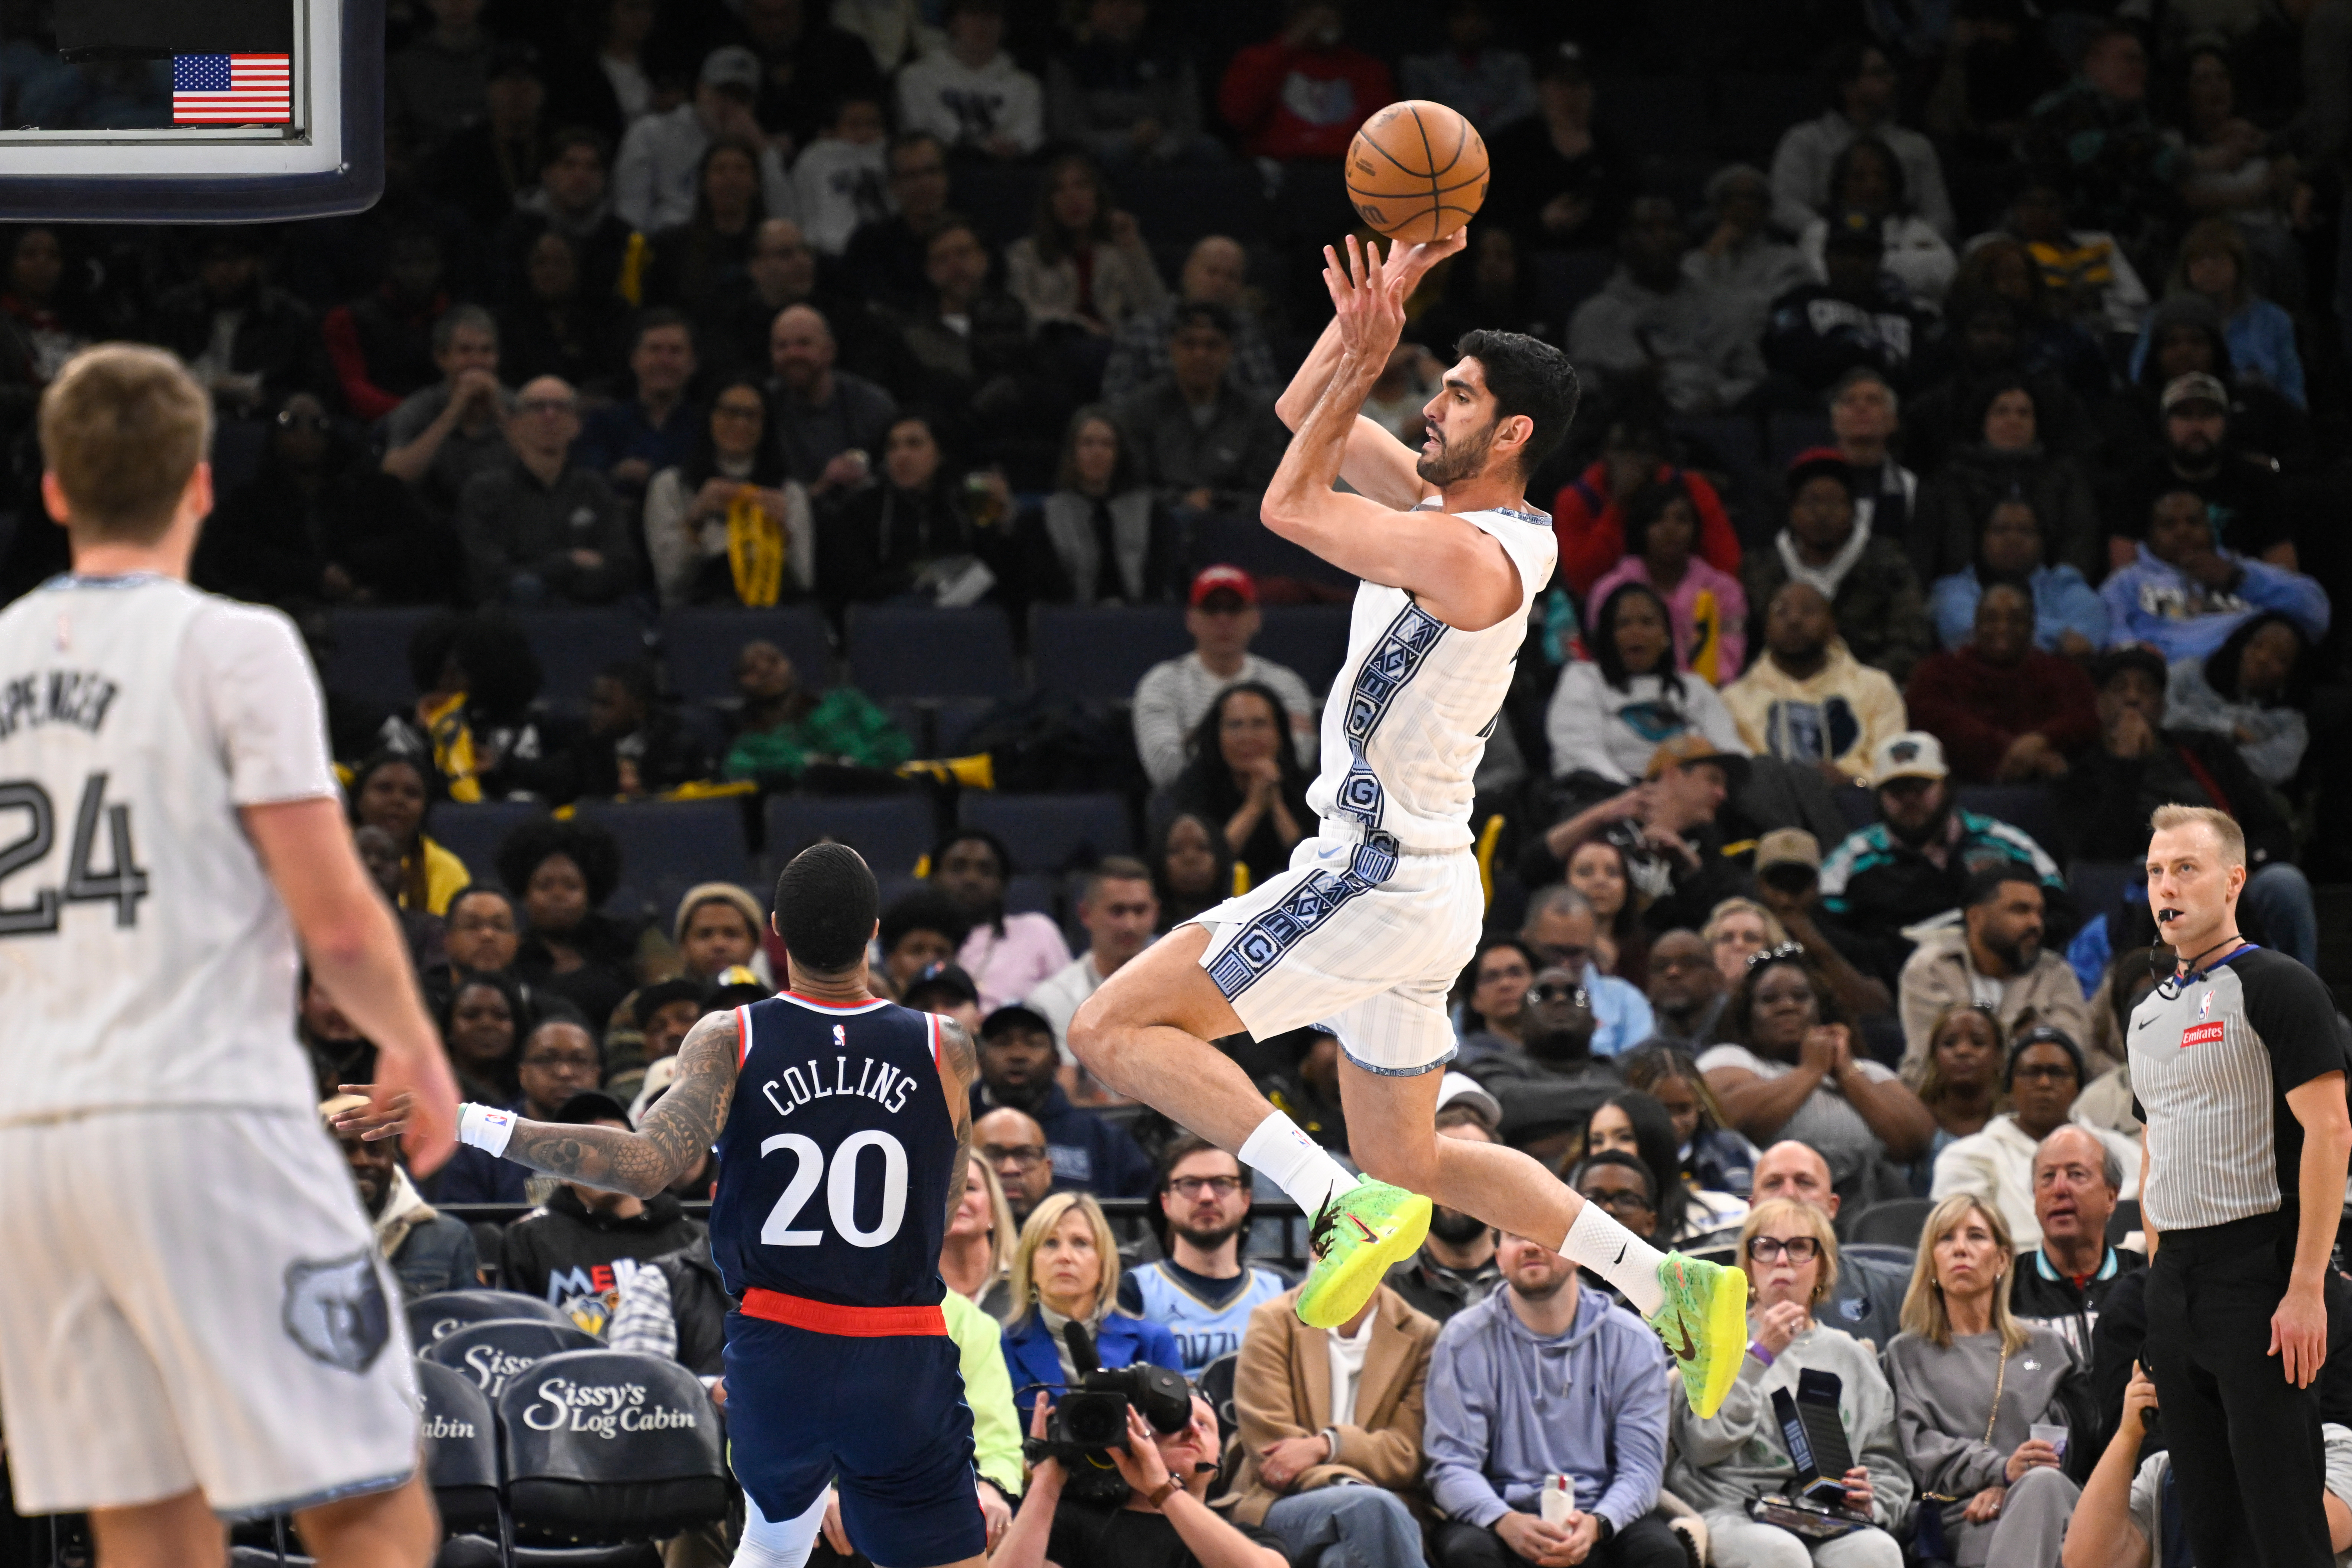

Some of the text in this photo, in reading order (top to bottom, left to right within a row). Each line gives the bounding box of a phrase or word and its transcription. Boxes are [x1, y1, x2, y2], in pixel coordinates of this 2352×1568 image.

[0, 670, 120, 741] PENCER
[0, 771, 147, 936] 24
[2183, 1027, 2223, 1044] Emirates
[763, 1056, 917, 1116] COLLINS
[761, 1130, 908, 1248] 20
[546, 1264, 615, 1307] ME
[421, 1415, 475, 1438] abin
[523, 1377, 646, 1431] Sissy's
[570, 1405, 697, 1439] Log Cabin
